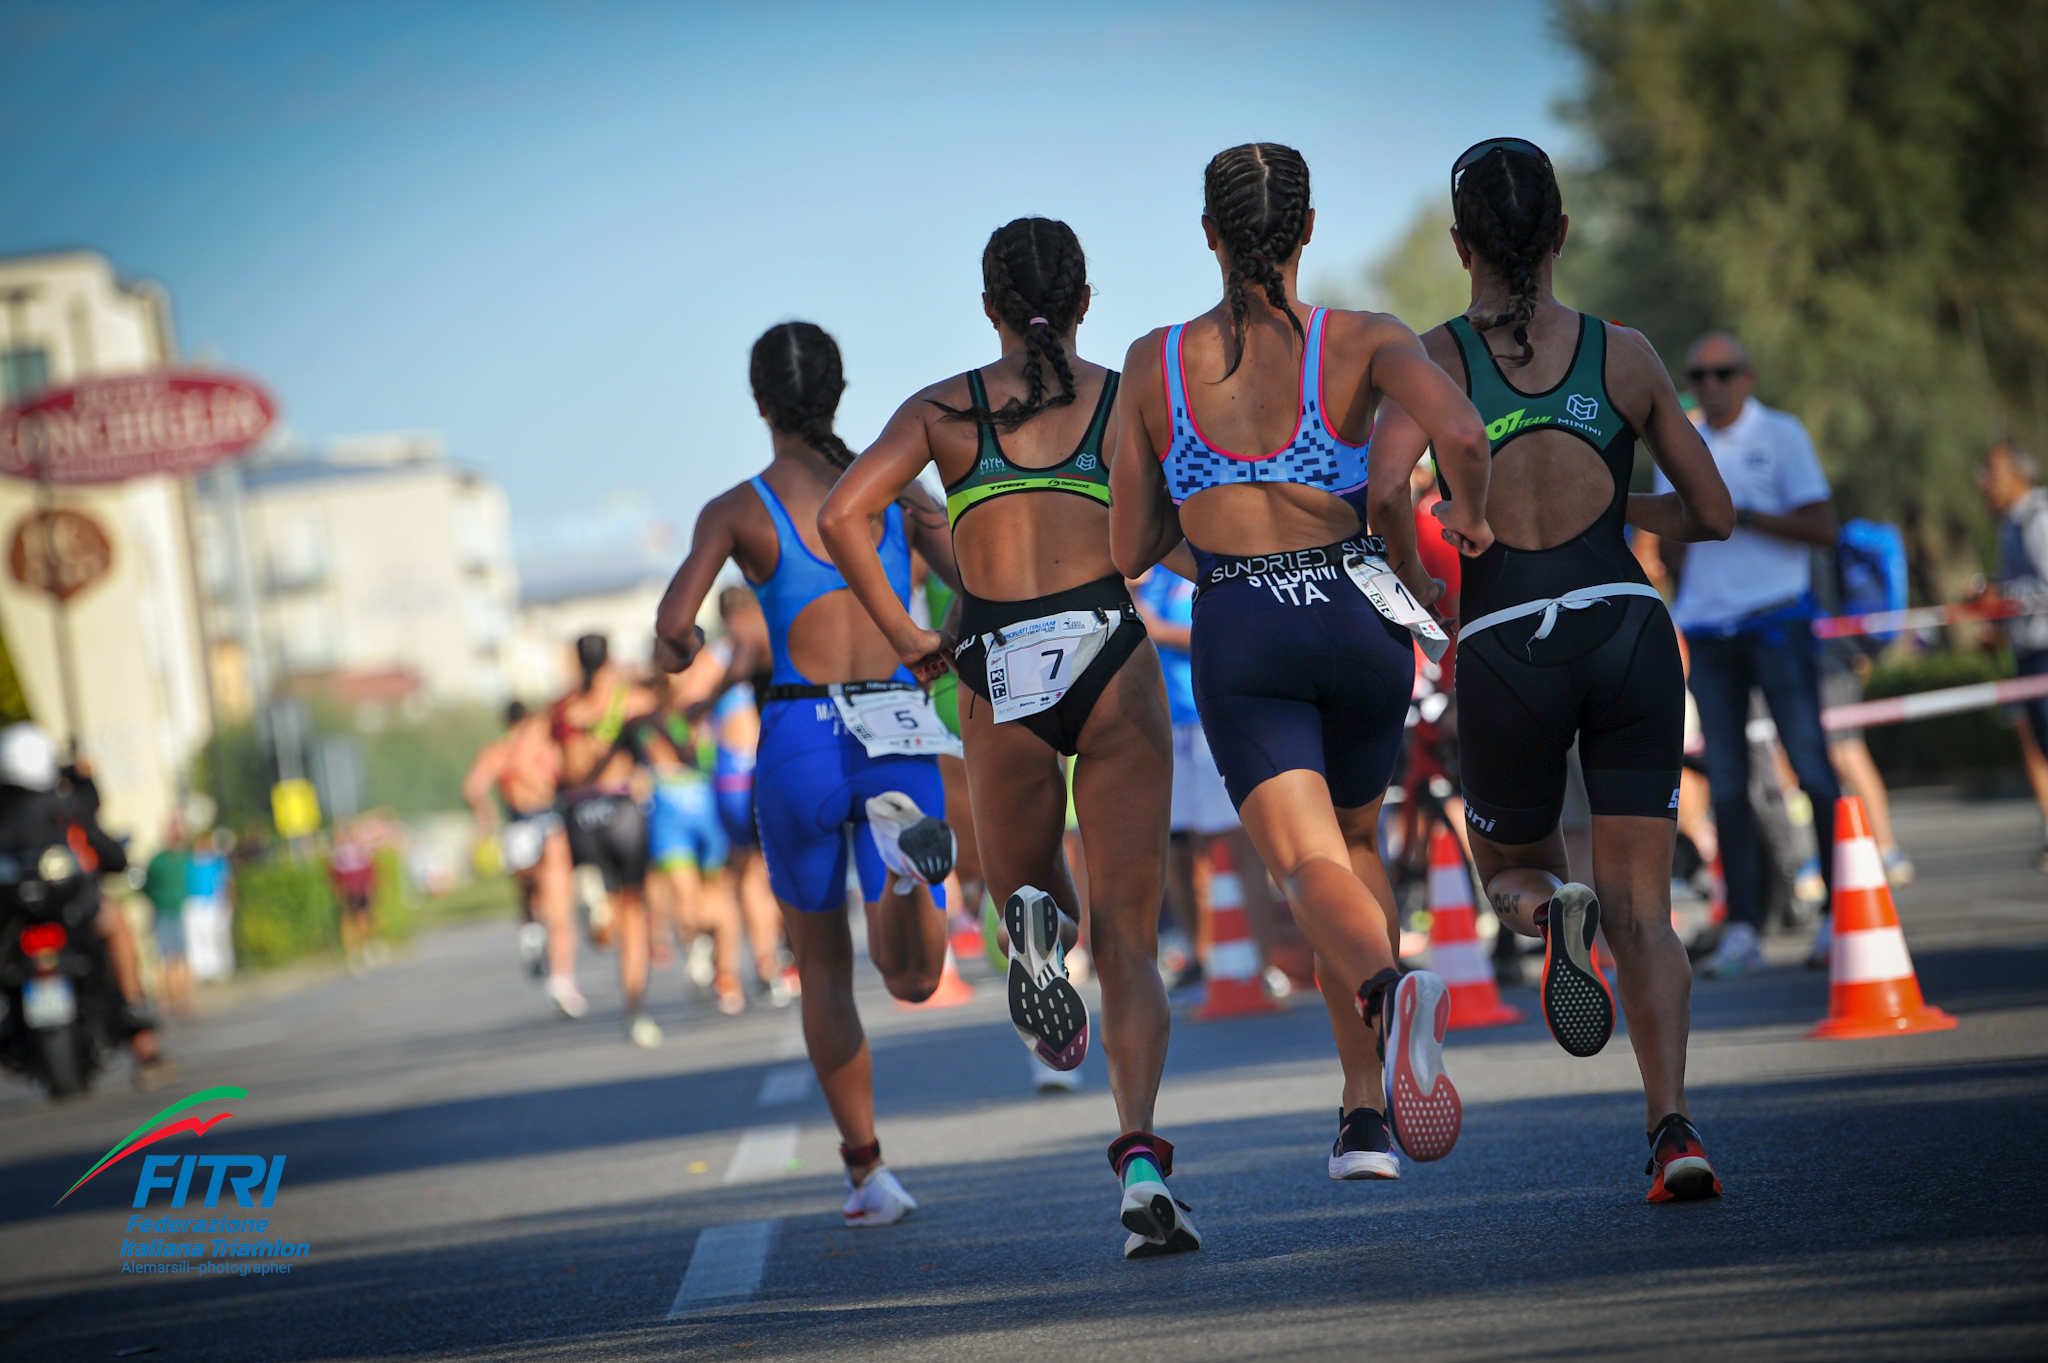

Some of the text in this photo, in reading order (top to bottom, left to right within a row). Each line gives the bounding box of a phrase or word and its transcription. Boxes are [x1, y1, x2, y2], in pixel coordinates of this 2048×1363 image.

[1486, 408, 1552, 441] 07 TEAM
[1557, 417, 1602, 437] MININI
[980, 458, 1005, 471] MYM
[988, 481, 1028, 490] TREK
[1211, 548, 1327, 584] SUNDRIED
[1270, 581, 1331, 606] ITA
[1395, 582, 1416, 611] 1
[1028, 620, 1056, 632] ITALIANI
[1041, 648, 1064, 681] 7
[894, 710, 918, 730] 5
[1668, 788, 1680, 809] S
[1464, 798, 1497, 832] tini
